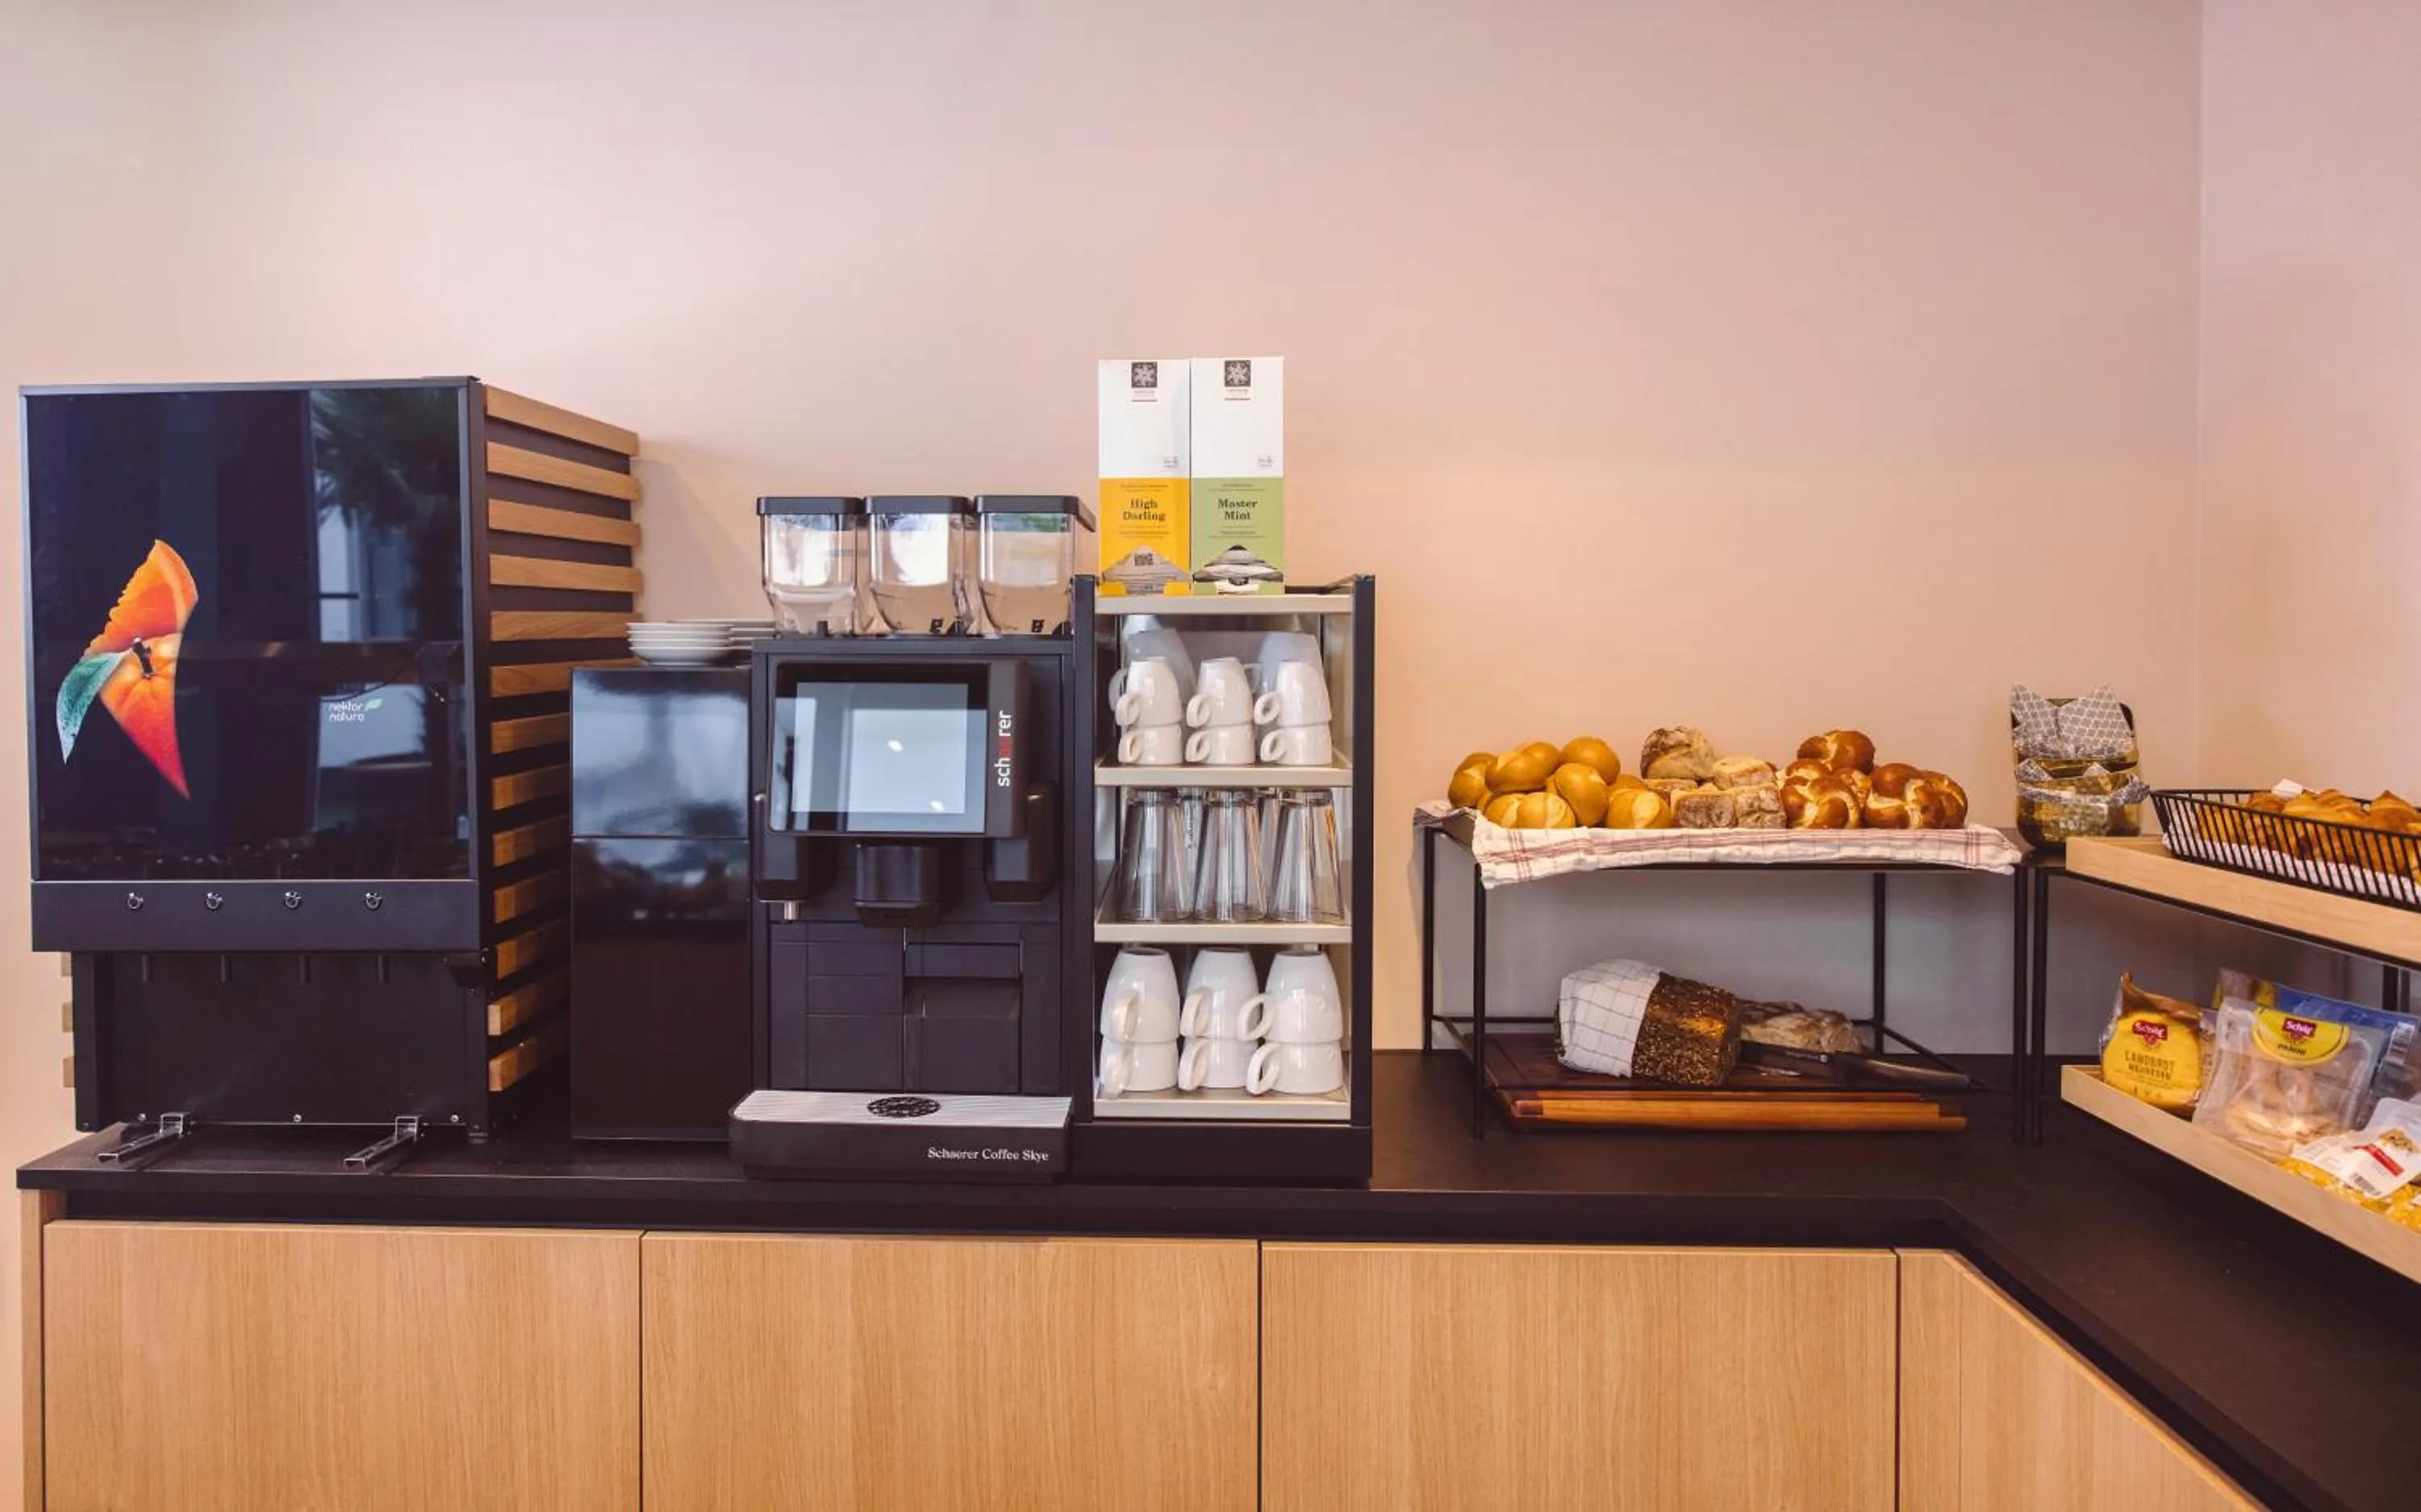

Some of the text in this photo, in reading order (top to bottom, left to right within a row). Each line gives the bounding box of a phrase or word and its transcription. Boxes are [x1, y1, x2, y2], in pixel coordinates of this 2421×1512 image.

[1130, 498, 1157, 509] High
[1218, 499, 1259, 508] Master
[1224, 510, 1252, 520] Mint
[928, 1147, 1049, 1163] Schaerer Coffee Skye
